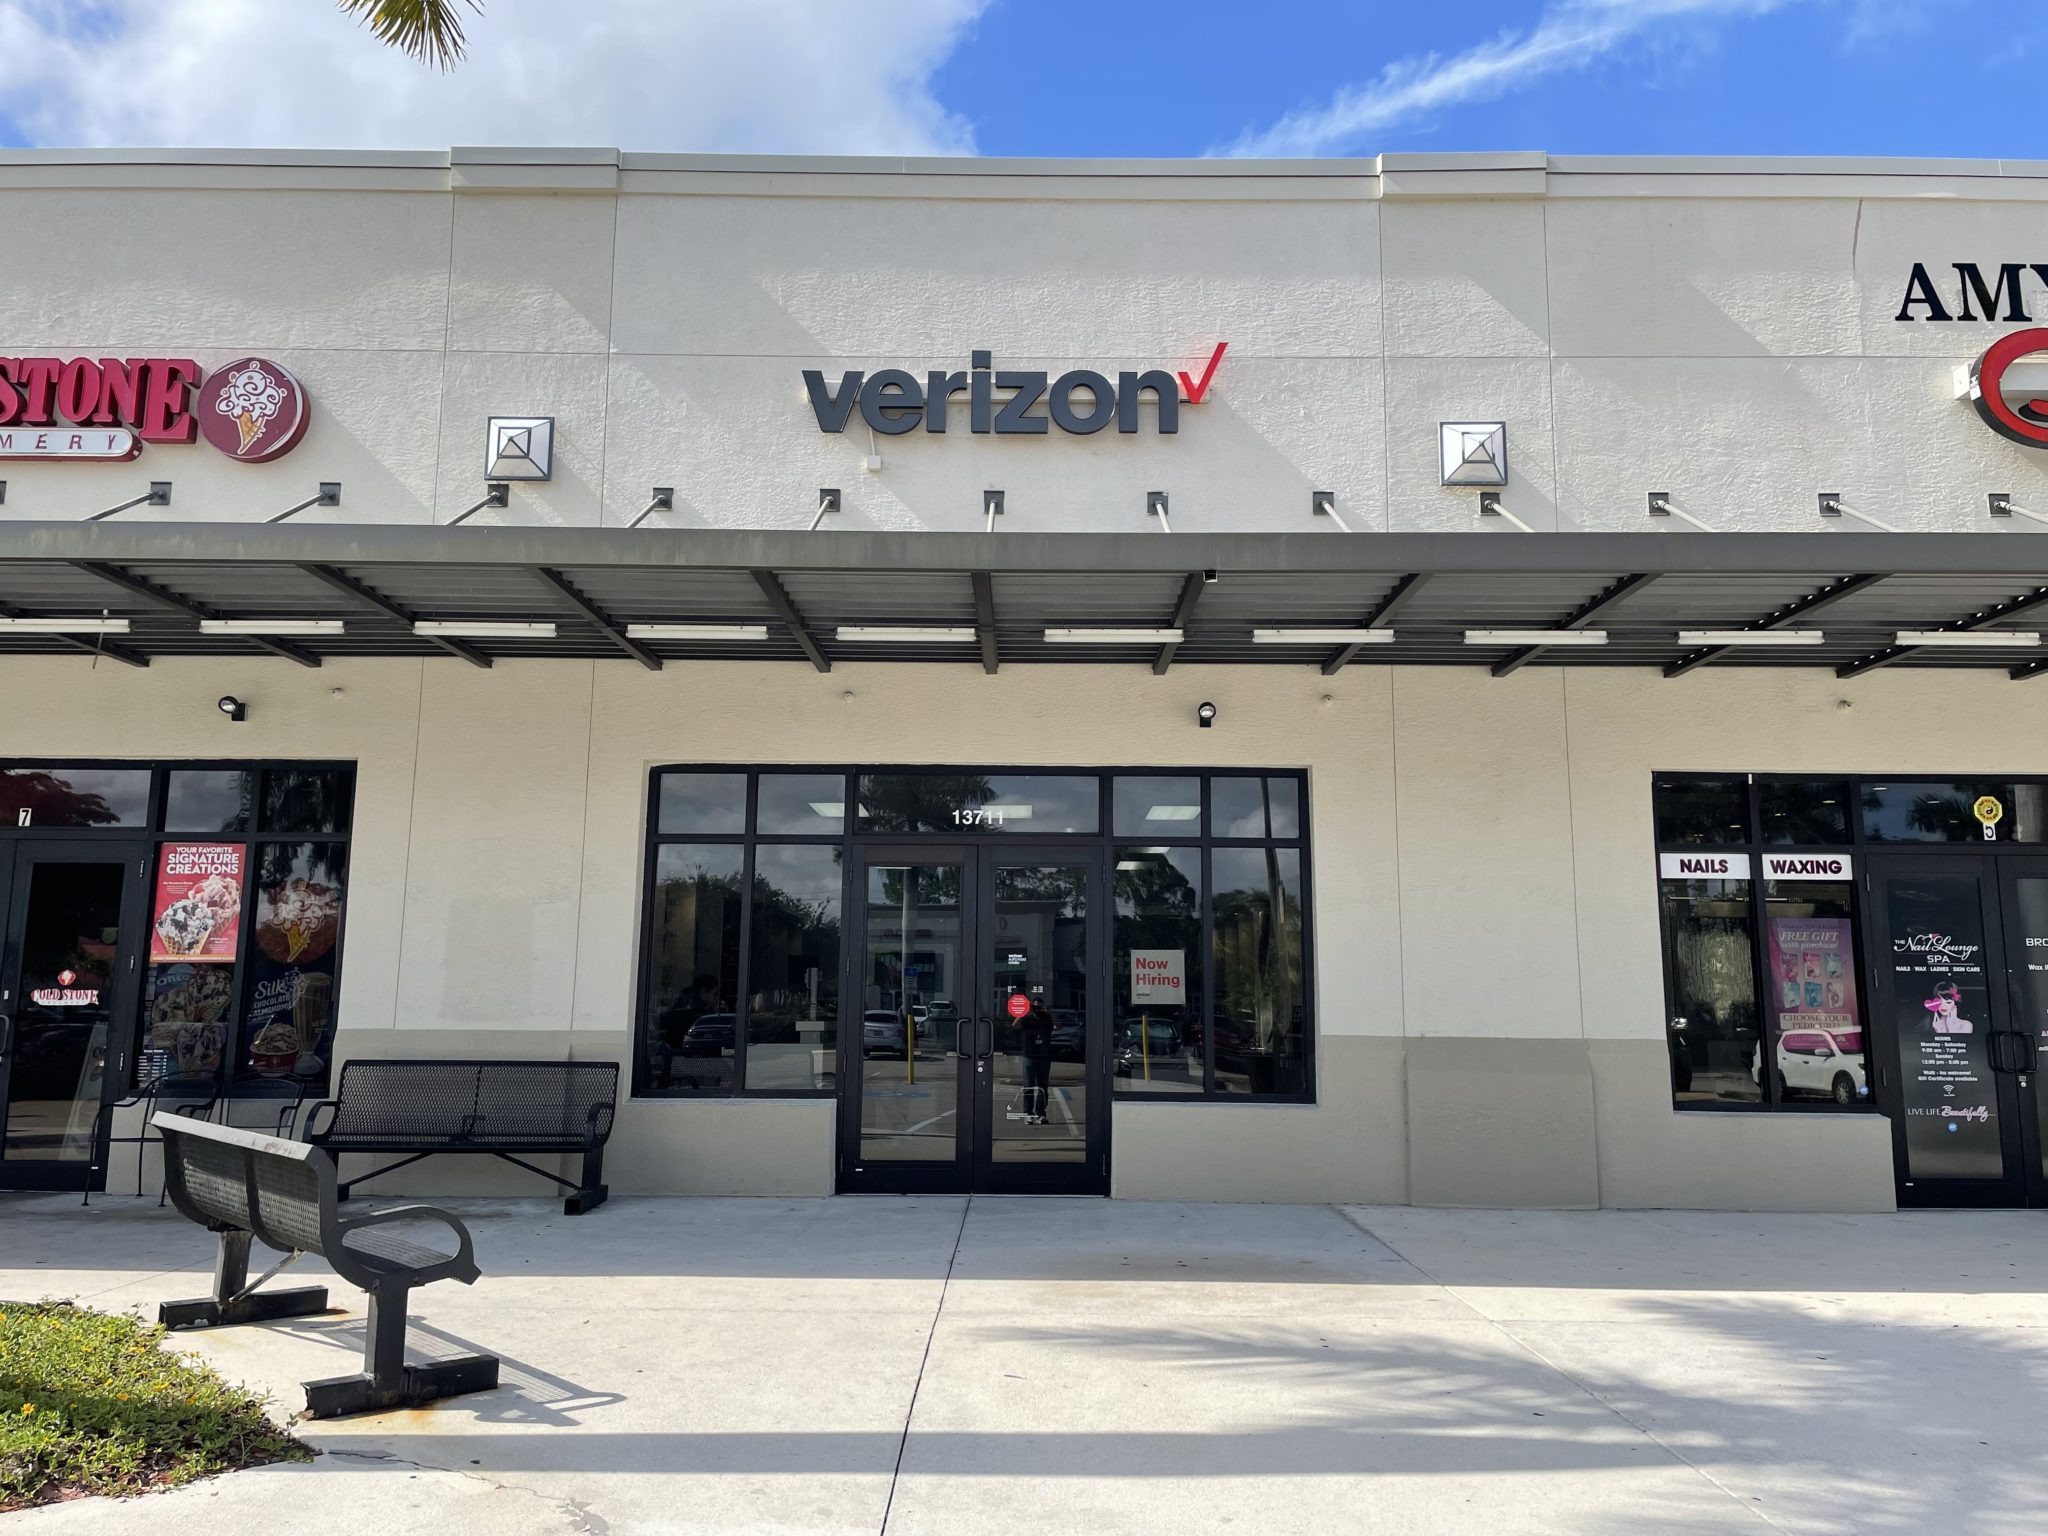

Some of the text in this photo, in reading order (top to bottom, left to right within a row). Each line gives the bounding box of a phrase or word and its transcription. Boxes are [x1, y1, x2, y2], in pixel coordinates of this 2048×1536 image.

[801, 350, 1179, 434] verizon
[22, 809, 30, 825] 7
[952, 809, 1003, 825] 13711
[1985, 825, 1995, 839] 5
[168, 853, 240, 864] SIGNATURE
[166, 864, 239, 875] CREATIONS
[1679, 859, 1729, 873] NAILS
[1769, 859, 1842, 874] WAXING
[1780, 931, 1839, 941] FREE GIFT
[1894, 934, 1934, 951] Nail
[1931, 935, 1979, 961] Lounge
[1135, 957, 1168, 970] Now
[1926, 954, 1950, 963] SPA
[2028, 963, 2043, 971] Wax
[1136, 973, 1180, 988] Hiring
[31, 988, 98, 1004] COLD STONE
[1907, 1108, 1924, 1116] LIVE
[1925, 1108, 1940, 1116] LIFE
